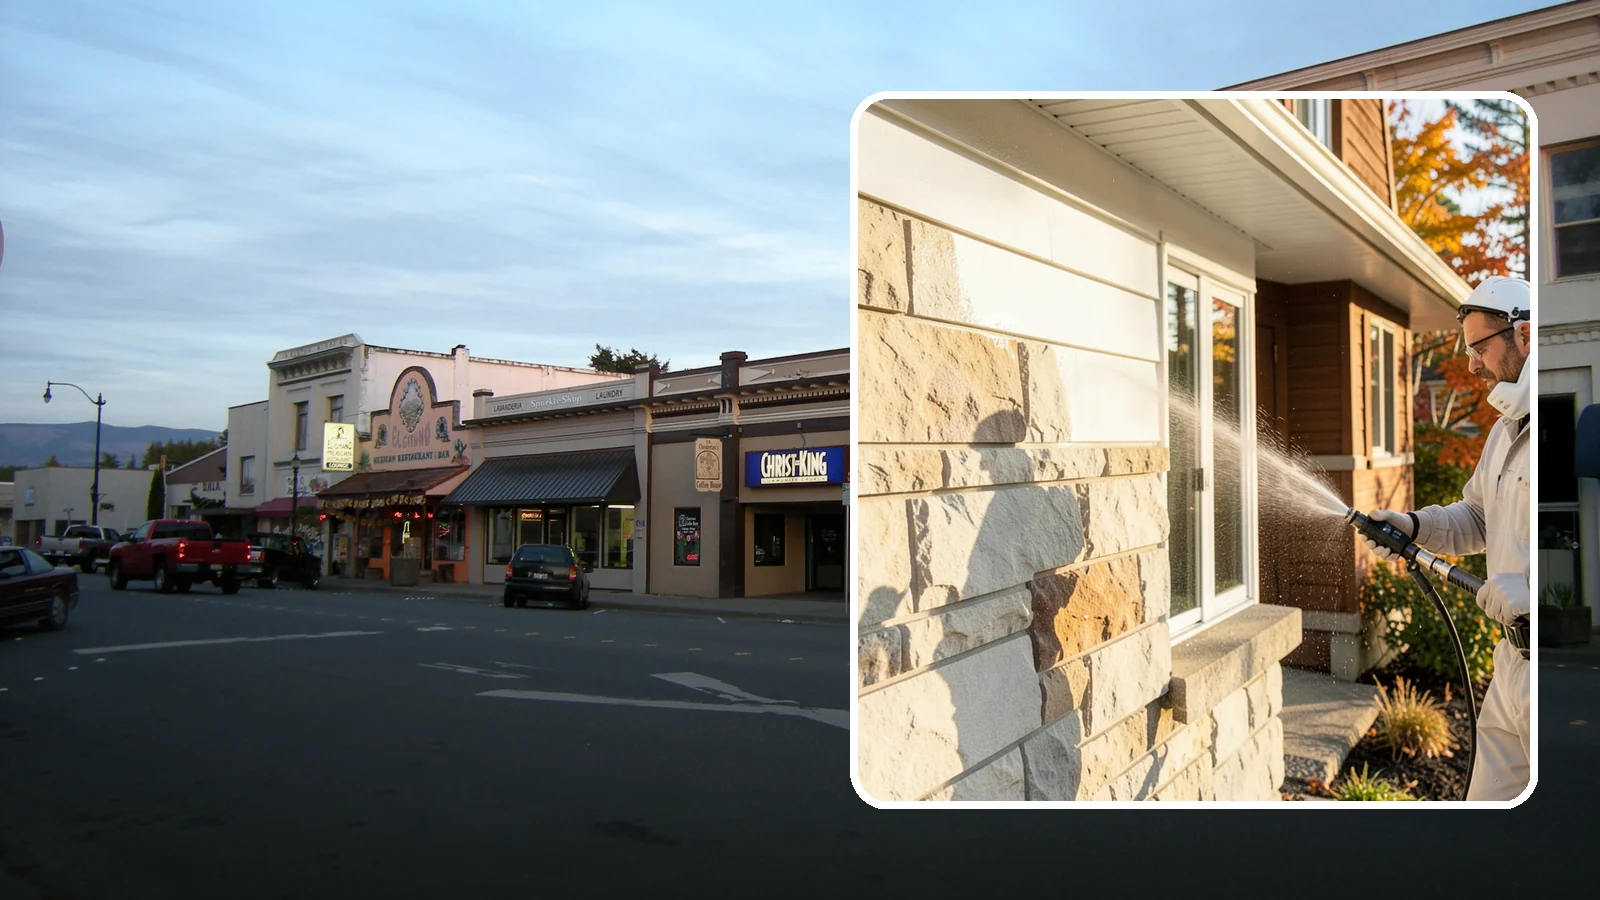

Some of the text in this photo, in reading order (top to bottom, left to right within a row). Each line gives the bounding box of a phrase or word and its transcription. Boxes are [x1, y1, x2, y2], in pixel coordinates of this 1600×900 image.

[595, 388, 624, 400] LAUNDRY
[493, 402, 523, 413] LAVANDERIA
[530, 394, 583, 409] Sparkle Shop
[373, 450, 450, 464] MEXICAN RESTAURANT BAR
[761, 449, 827, 478] CHRIST KING
